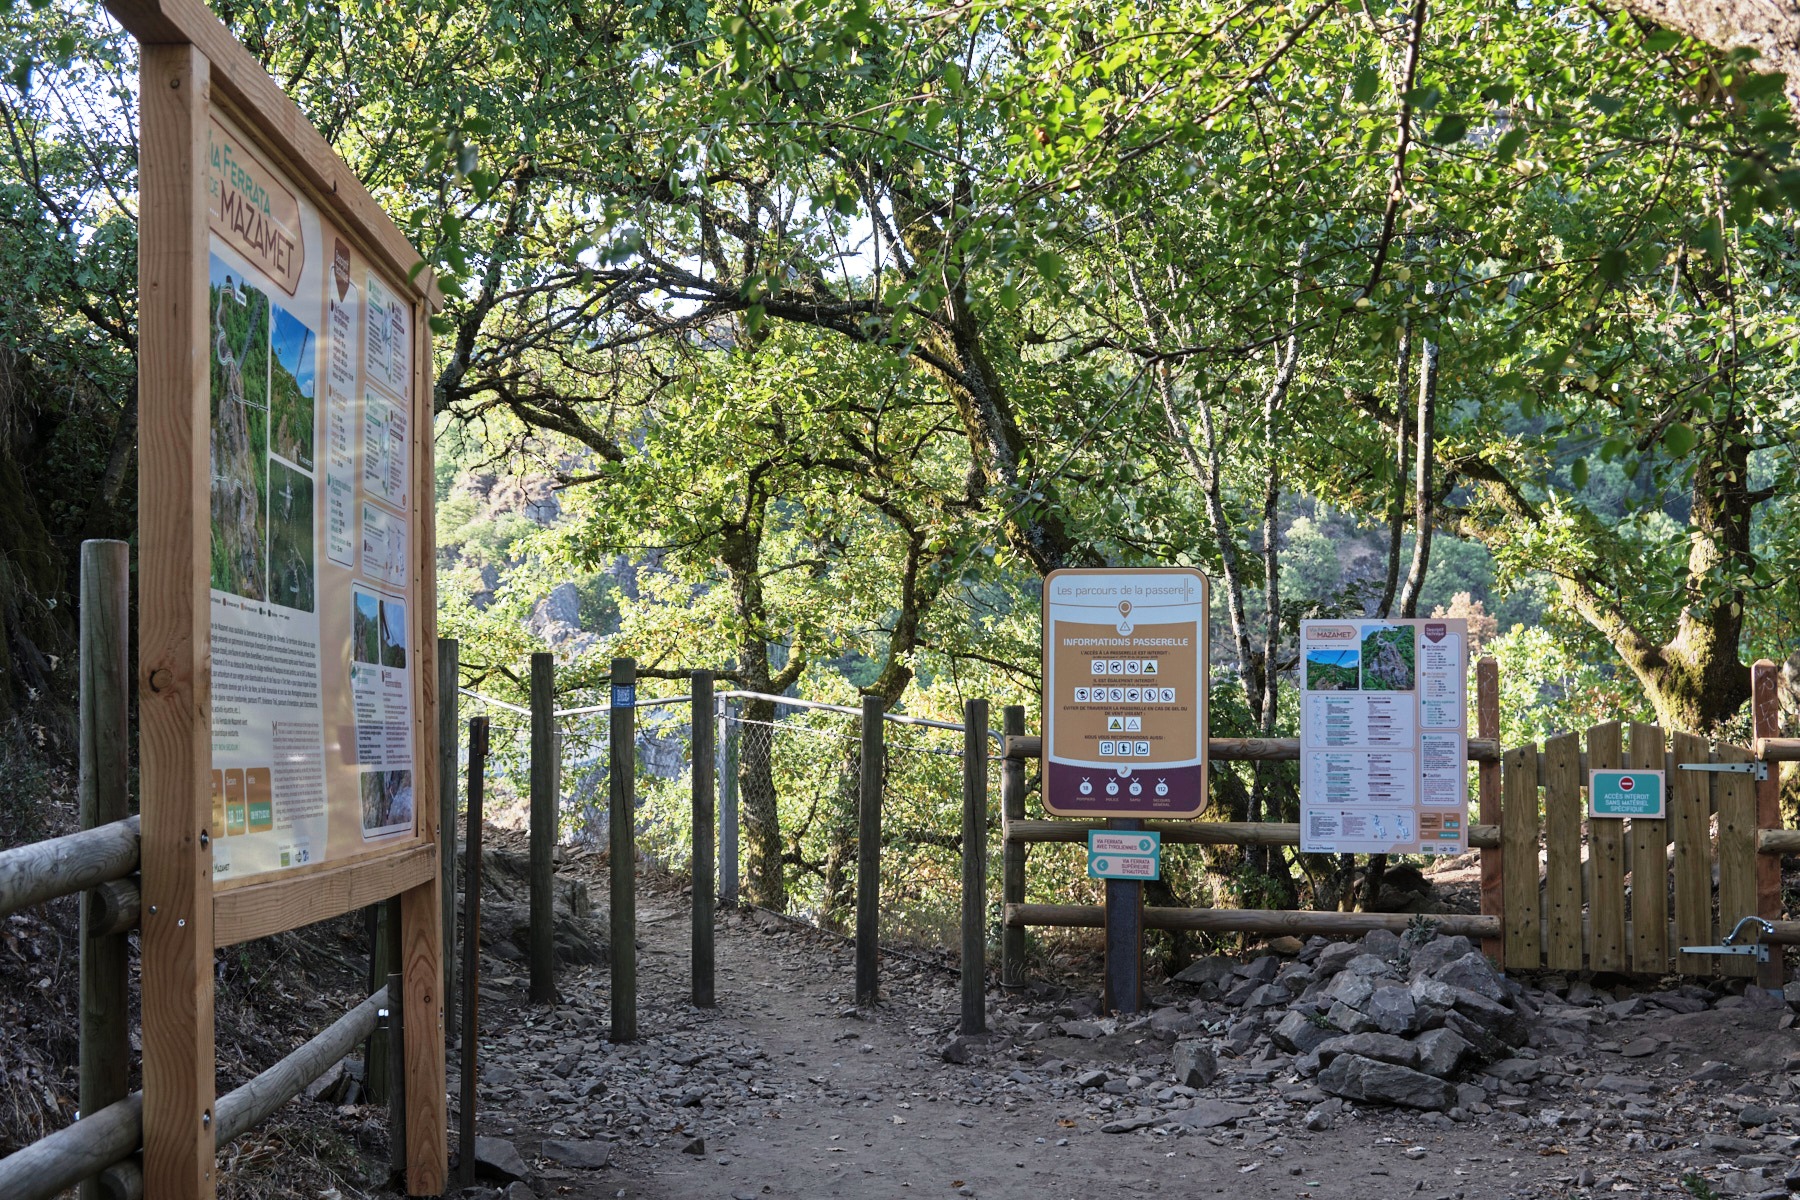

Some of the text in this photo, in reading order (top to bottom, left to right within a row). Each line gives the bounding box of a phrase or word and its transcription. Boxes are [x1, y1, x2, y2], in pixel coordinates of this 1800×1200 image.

[208, 129, 271, 217] IA FERRATA
[220, 179, 294, 279] MAZAMET
[1057, 578, 1194, 602] Les parcours de la passerelle
[1063, 638, 1189, 646] INFORMATIONS PASSERELLE
